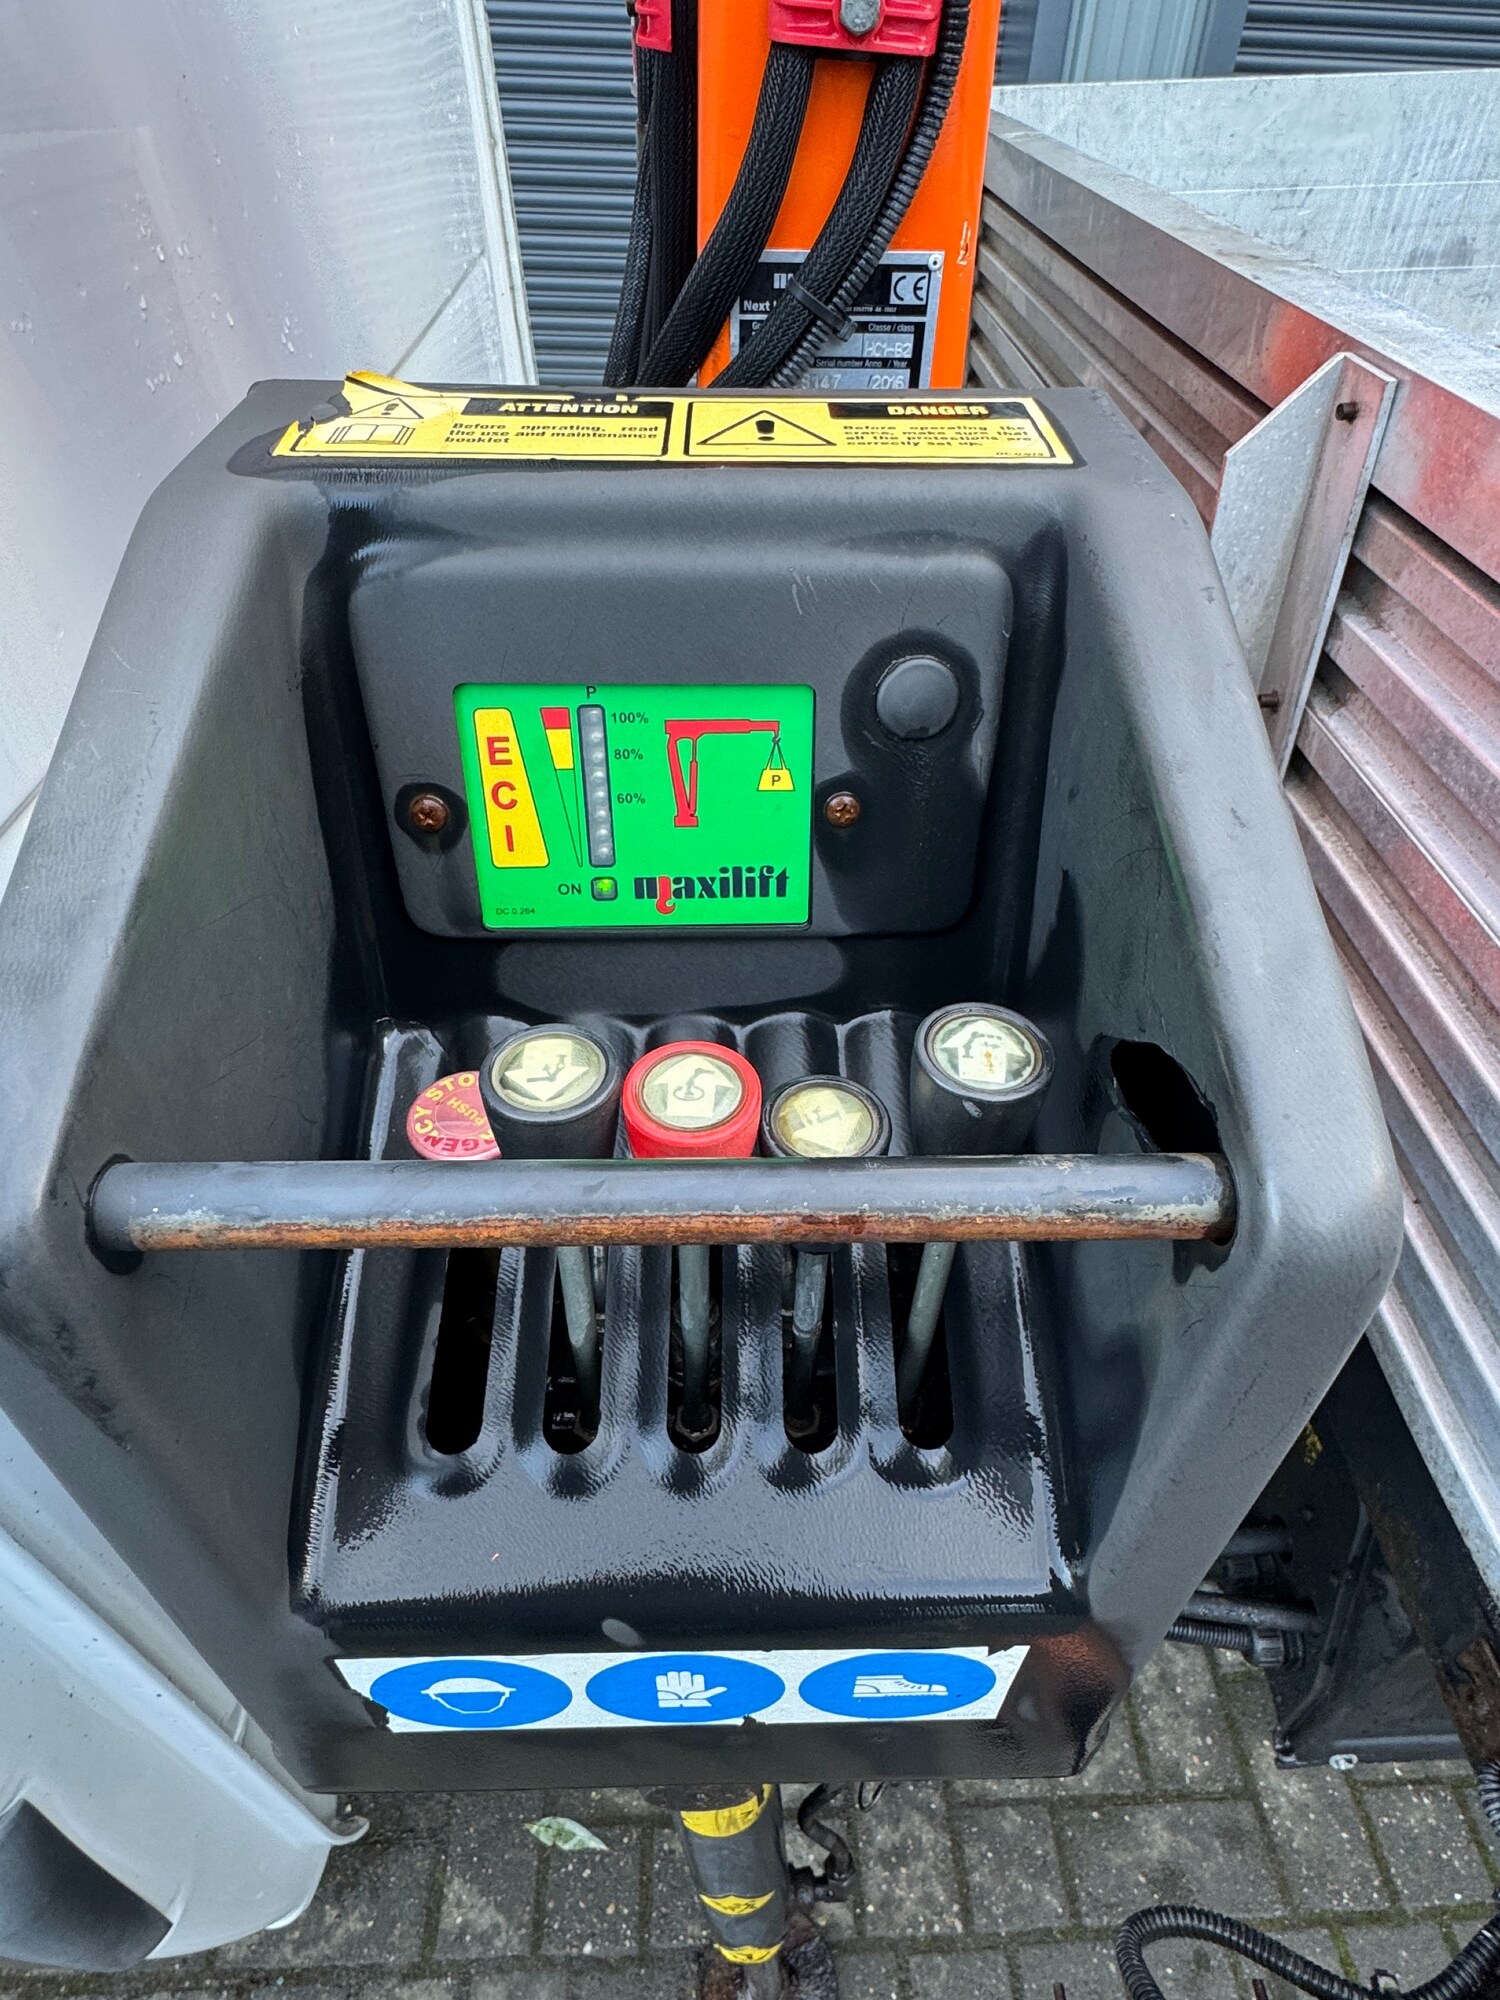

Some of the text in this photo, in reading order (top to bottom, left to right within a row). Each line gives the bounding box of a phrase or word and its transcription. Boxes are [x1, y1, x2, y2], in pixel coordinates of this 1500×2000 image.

[893, 275, 926, 302] CE
[743, 300, 770, 312] Next
[868, 323, 891, 332] Classe
[898, 323, 915, 332] class
[815, 359, 863, 367] Serial number
[864, 359, 882, 368] Anno
[893, 360, 908, 368] Year
[498, 402, 639, 414] ATTENTION
[887, 405, 989, 415] DANGER
[550, 431, 658, 439] maintenance
[586, 686, 597, 699] P
[610, 712, 649, 725] 100%
[614, 748, 644, 761] 80%
[771, 774, 781, 786] P
[617, 792, 646, 805] 60%
[557, 883, 582, 896] ON
[634, 865, 790, 914] maxilift
[425, 1073, 476, 1101] STO
[446, 1096, 487, 1127] PUSH
